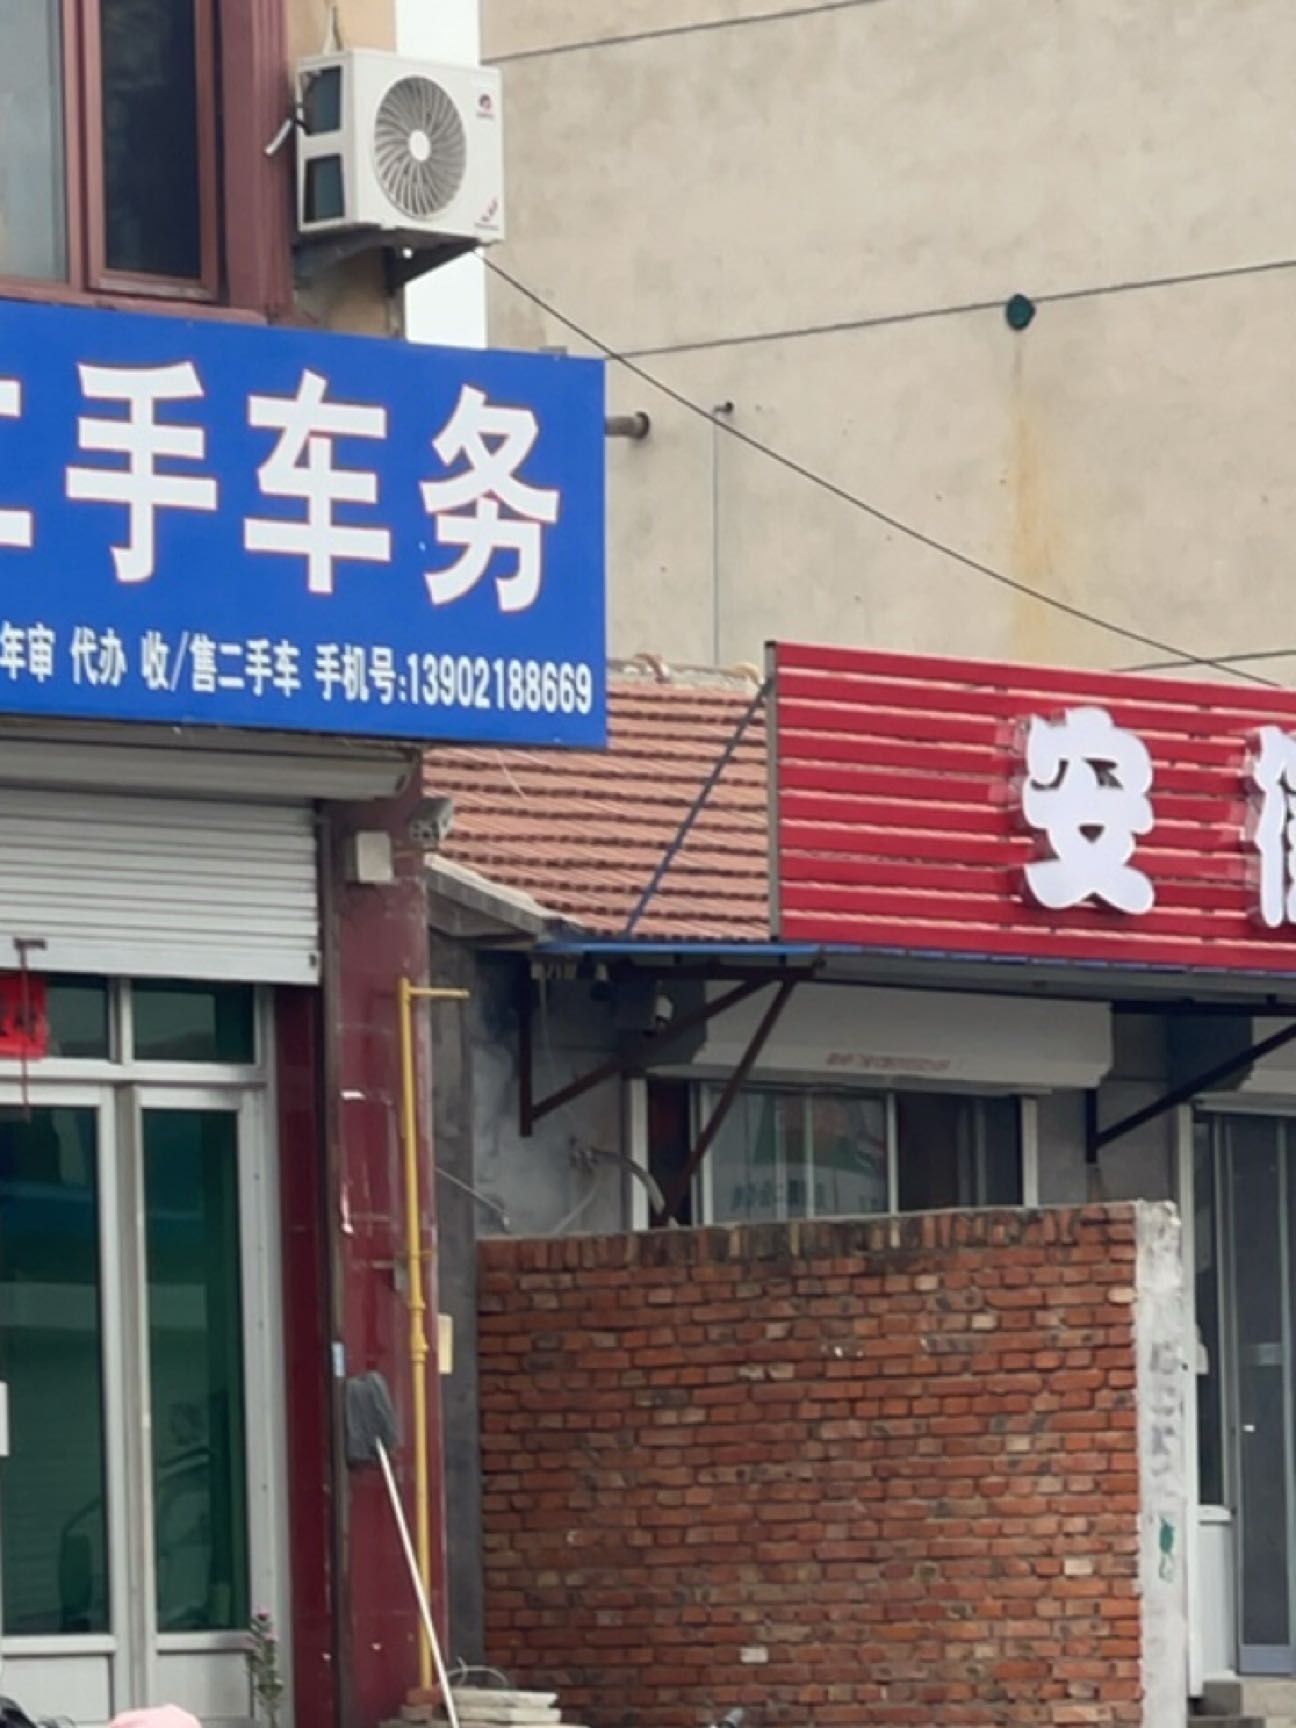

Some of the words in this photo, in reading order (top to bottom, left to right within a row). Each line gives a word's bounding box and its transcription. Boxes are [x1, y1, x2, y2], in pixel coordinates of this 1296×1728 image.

[70, 626, 127, 687] 代办
[141, 631, 301, 698] 收/售二手车
